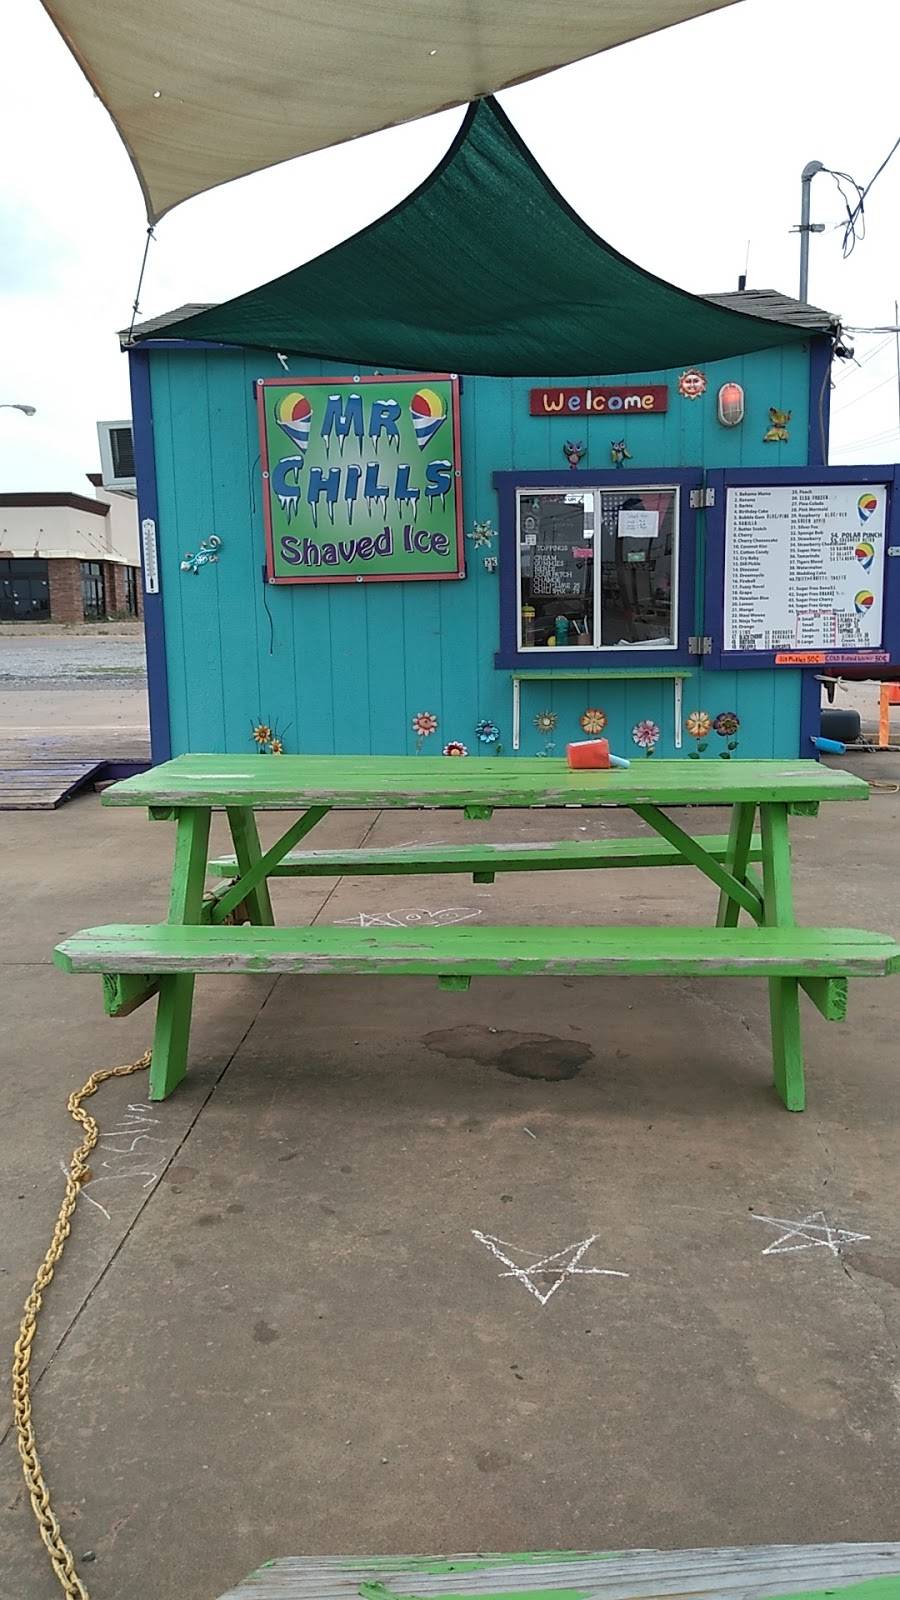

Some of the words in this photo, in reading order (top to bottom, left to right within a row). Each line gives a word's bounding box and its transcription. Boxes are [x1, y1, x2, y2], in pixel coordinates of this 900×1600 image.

[543, 389, 655, 411] Welcome
[320, 394, 402, 451] MR
[271, 455, 453, 517] CHILLS
[280, 526, 394, 567] Shaved
[403, 524, 450, 555] Ice
[862, 531, 883, 539] PUNCH
